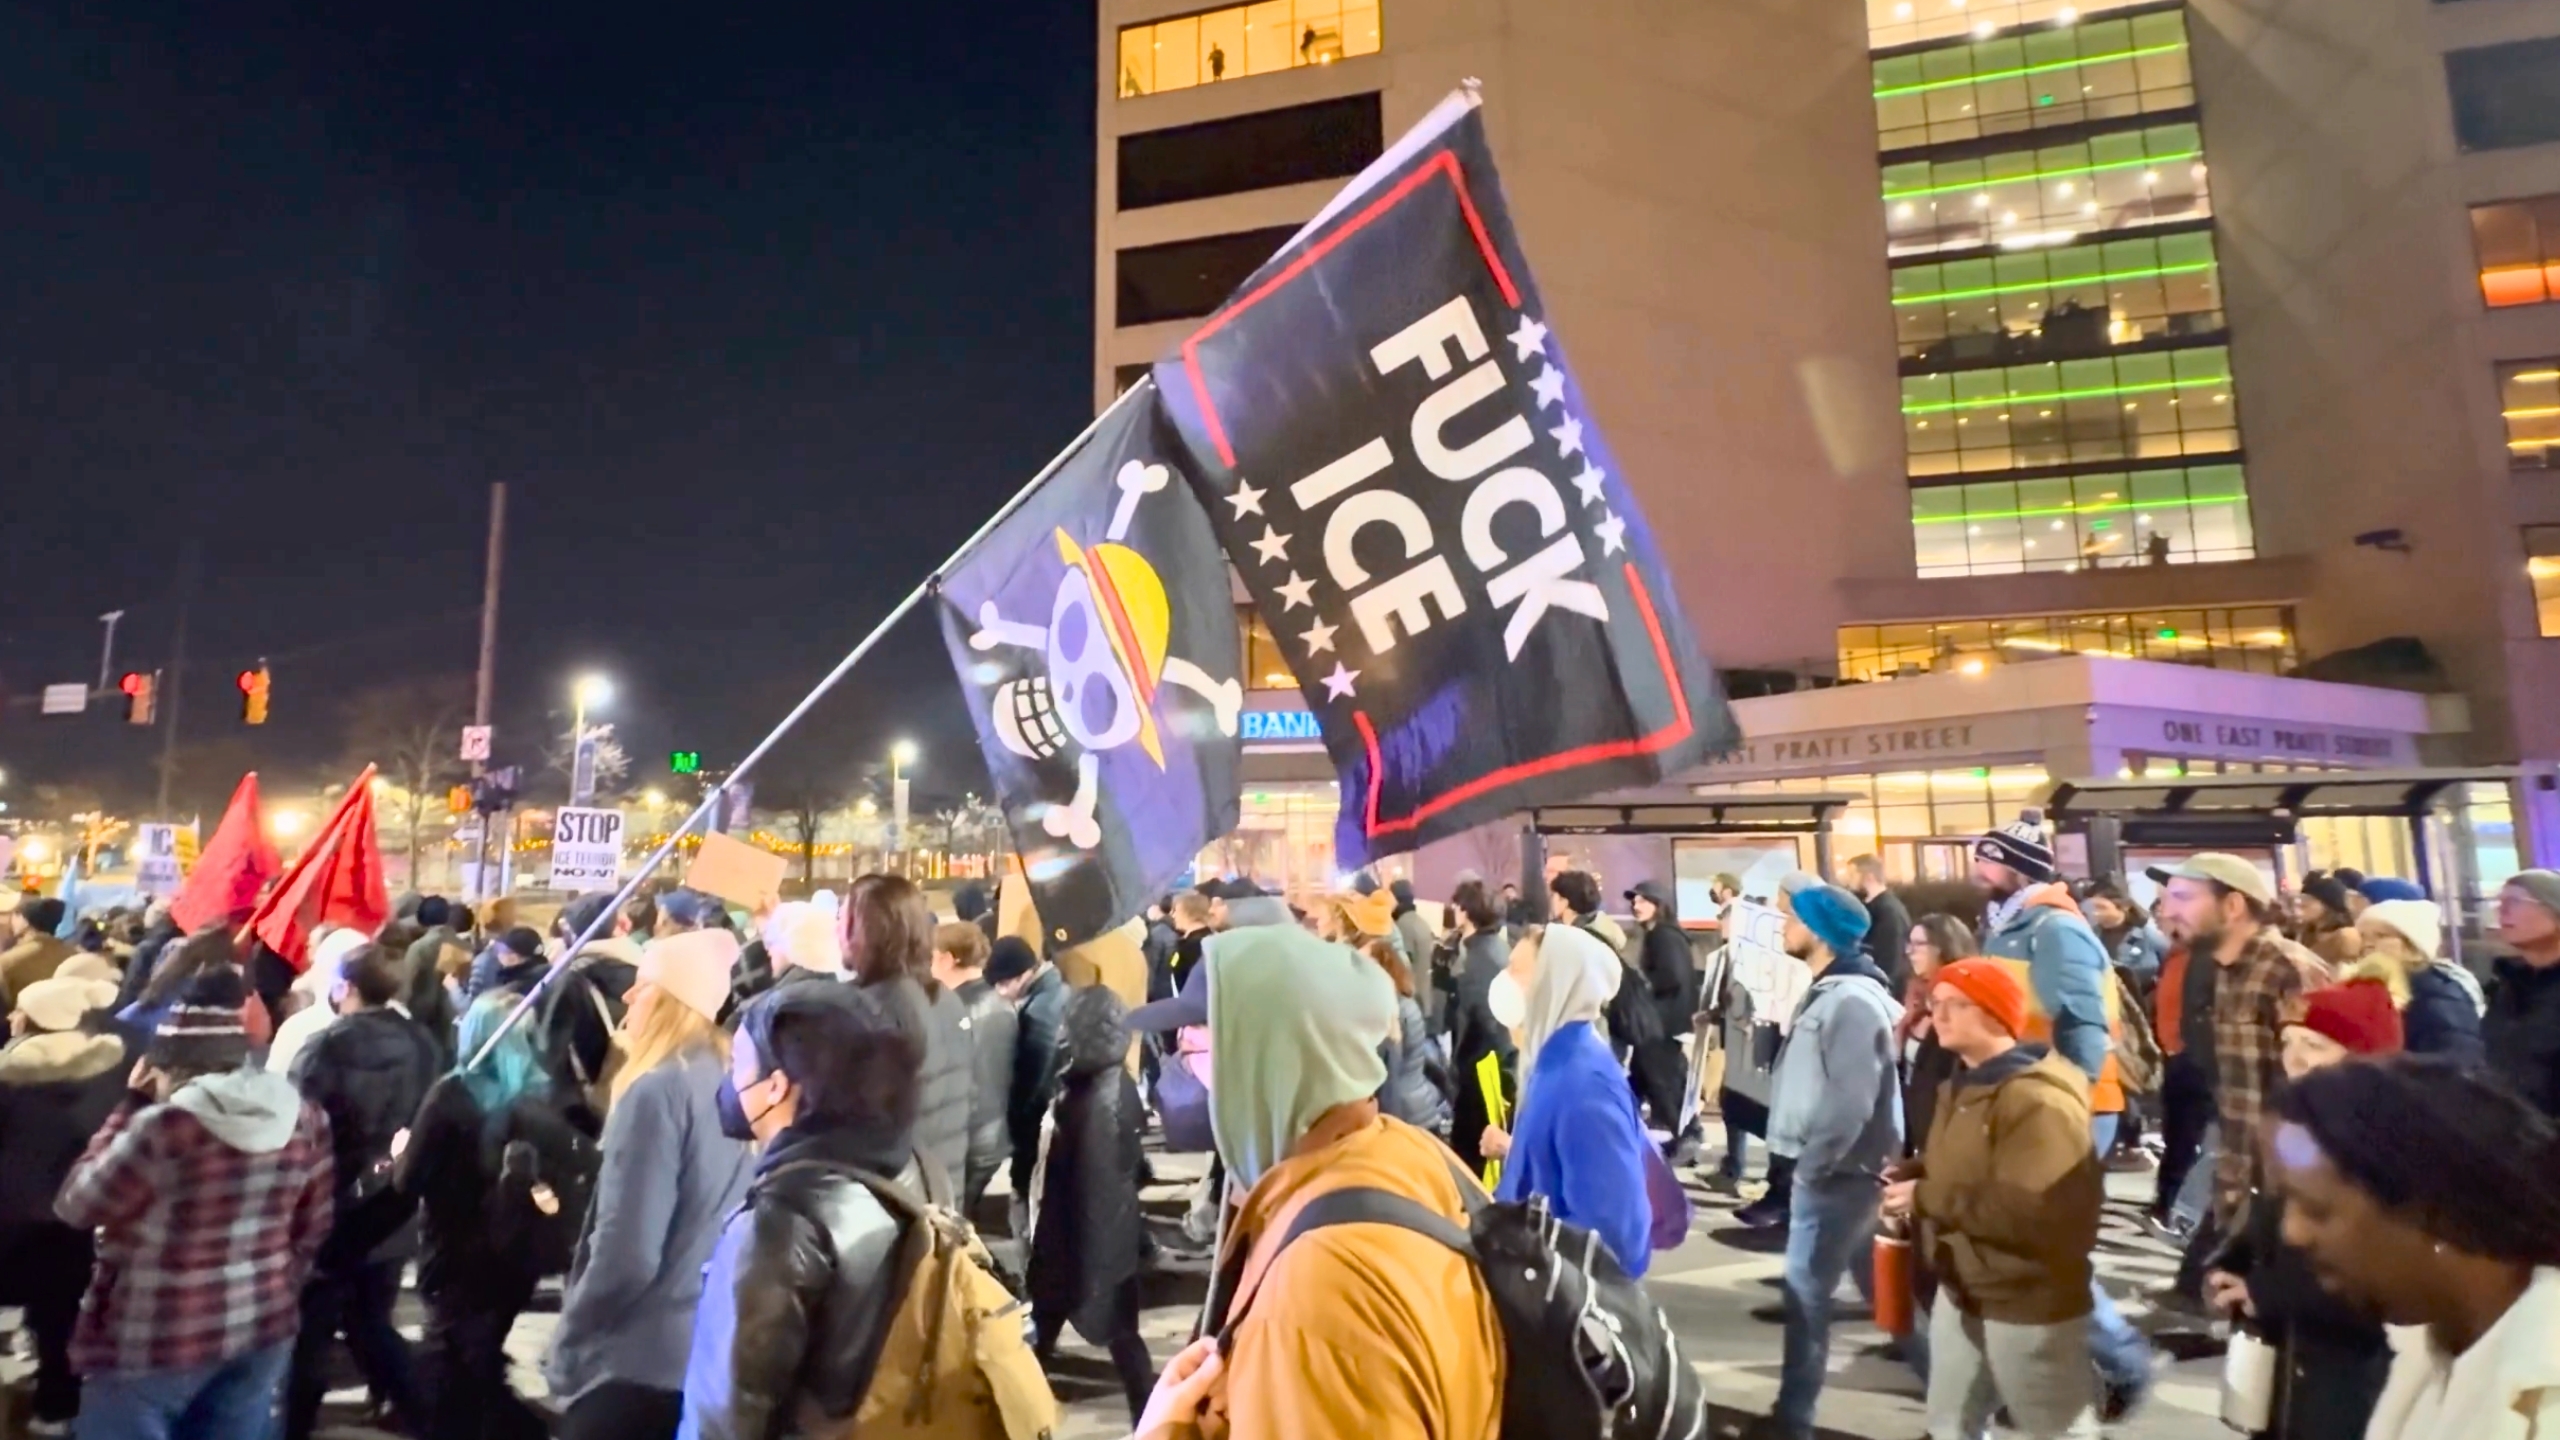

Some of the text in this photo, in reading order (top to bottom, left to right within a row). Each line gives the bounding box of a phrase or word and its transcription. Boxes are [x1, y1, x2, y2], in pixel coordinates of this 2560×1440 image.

[1370, 295, 1609, 663] FUCK
[1290, 436, 1467, 656] ICE
[1774, 736, 1851, 761] PRATT
[1867, 725, 1973, 754] STREET
[2163, 720, 2202, 744] ONE
[2216, 725, 2261, 748] EAST
[559, 812, 620, 843] STOP
[555, 851, 570, 865] ICE
